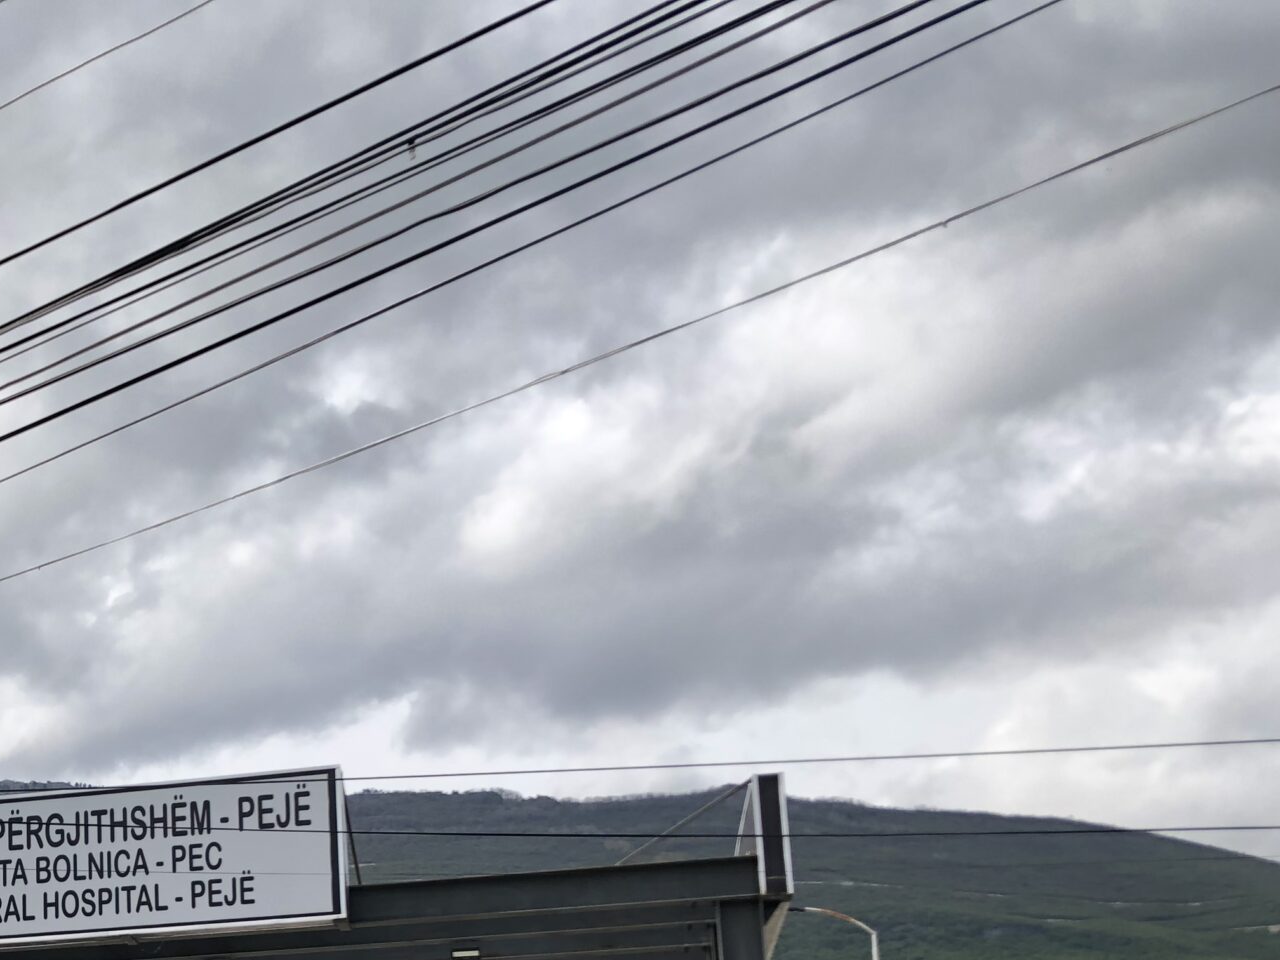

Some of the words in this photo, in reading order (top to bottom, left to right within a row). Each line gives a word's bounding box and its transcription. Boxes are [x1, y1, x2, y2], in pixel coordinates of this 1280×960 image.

[238, 783, 312, 832] PEJË
[35, 847, 150, 884] BOLNICA
[171, 841, 223, 873] PEC
[43, 883, 169, 920] HOSPITAL
[191, 870, 256, 909] PEJË
